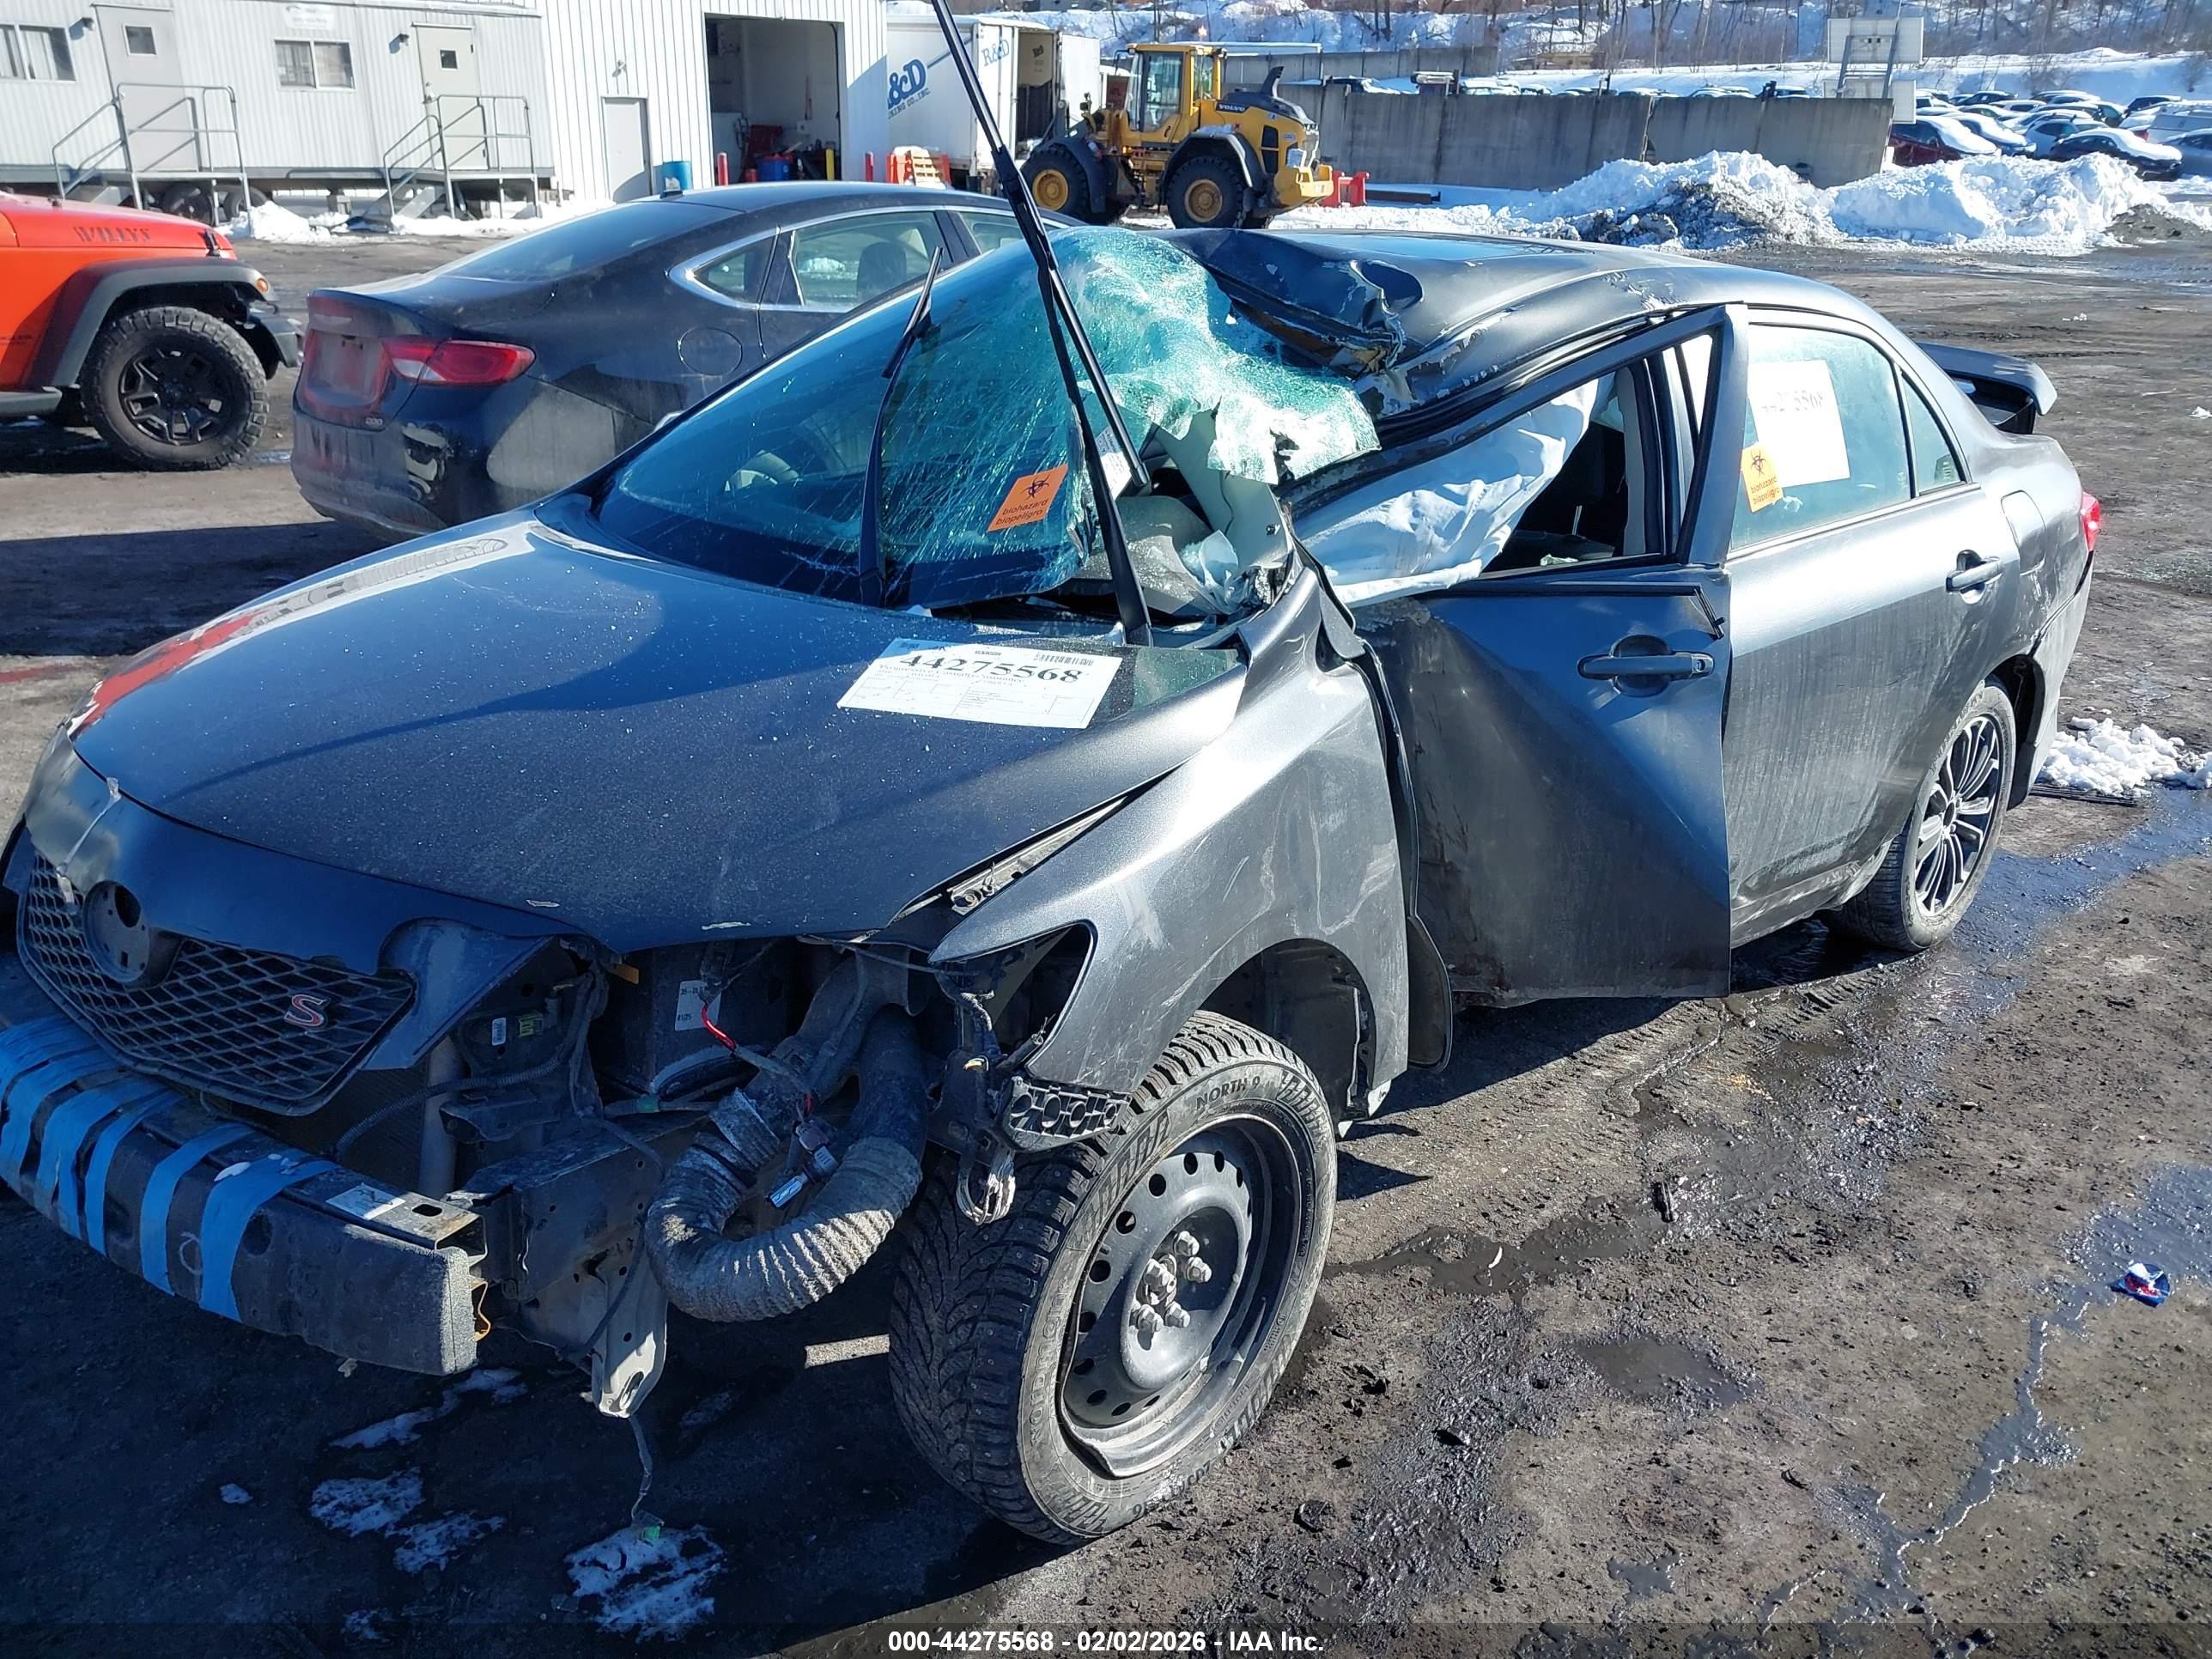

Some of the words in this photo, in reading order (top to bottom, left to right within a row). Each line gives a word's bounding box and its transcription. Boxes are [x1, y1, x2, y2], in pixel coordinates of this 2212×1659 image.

[981, 40, 1010, 67] R&D
[72, 226, 151, 242] WILLYS
[996, 509, 1043, 526] biopeligro
[1002, 498, 1048, 516] biohazard
[899, 654, 1083, 684] 44275568
[284, 994, 327, 1027] S
[1196, 1077, 1248, 1110] NORTH
[1252, 1075, 1261, 1090] 9
